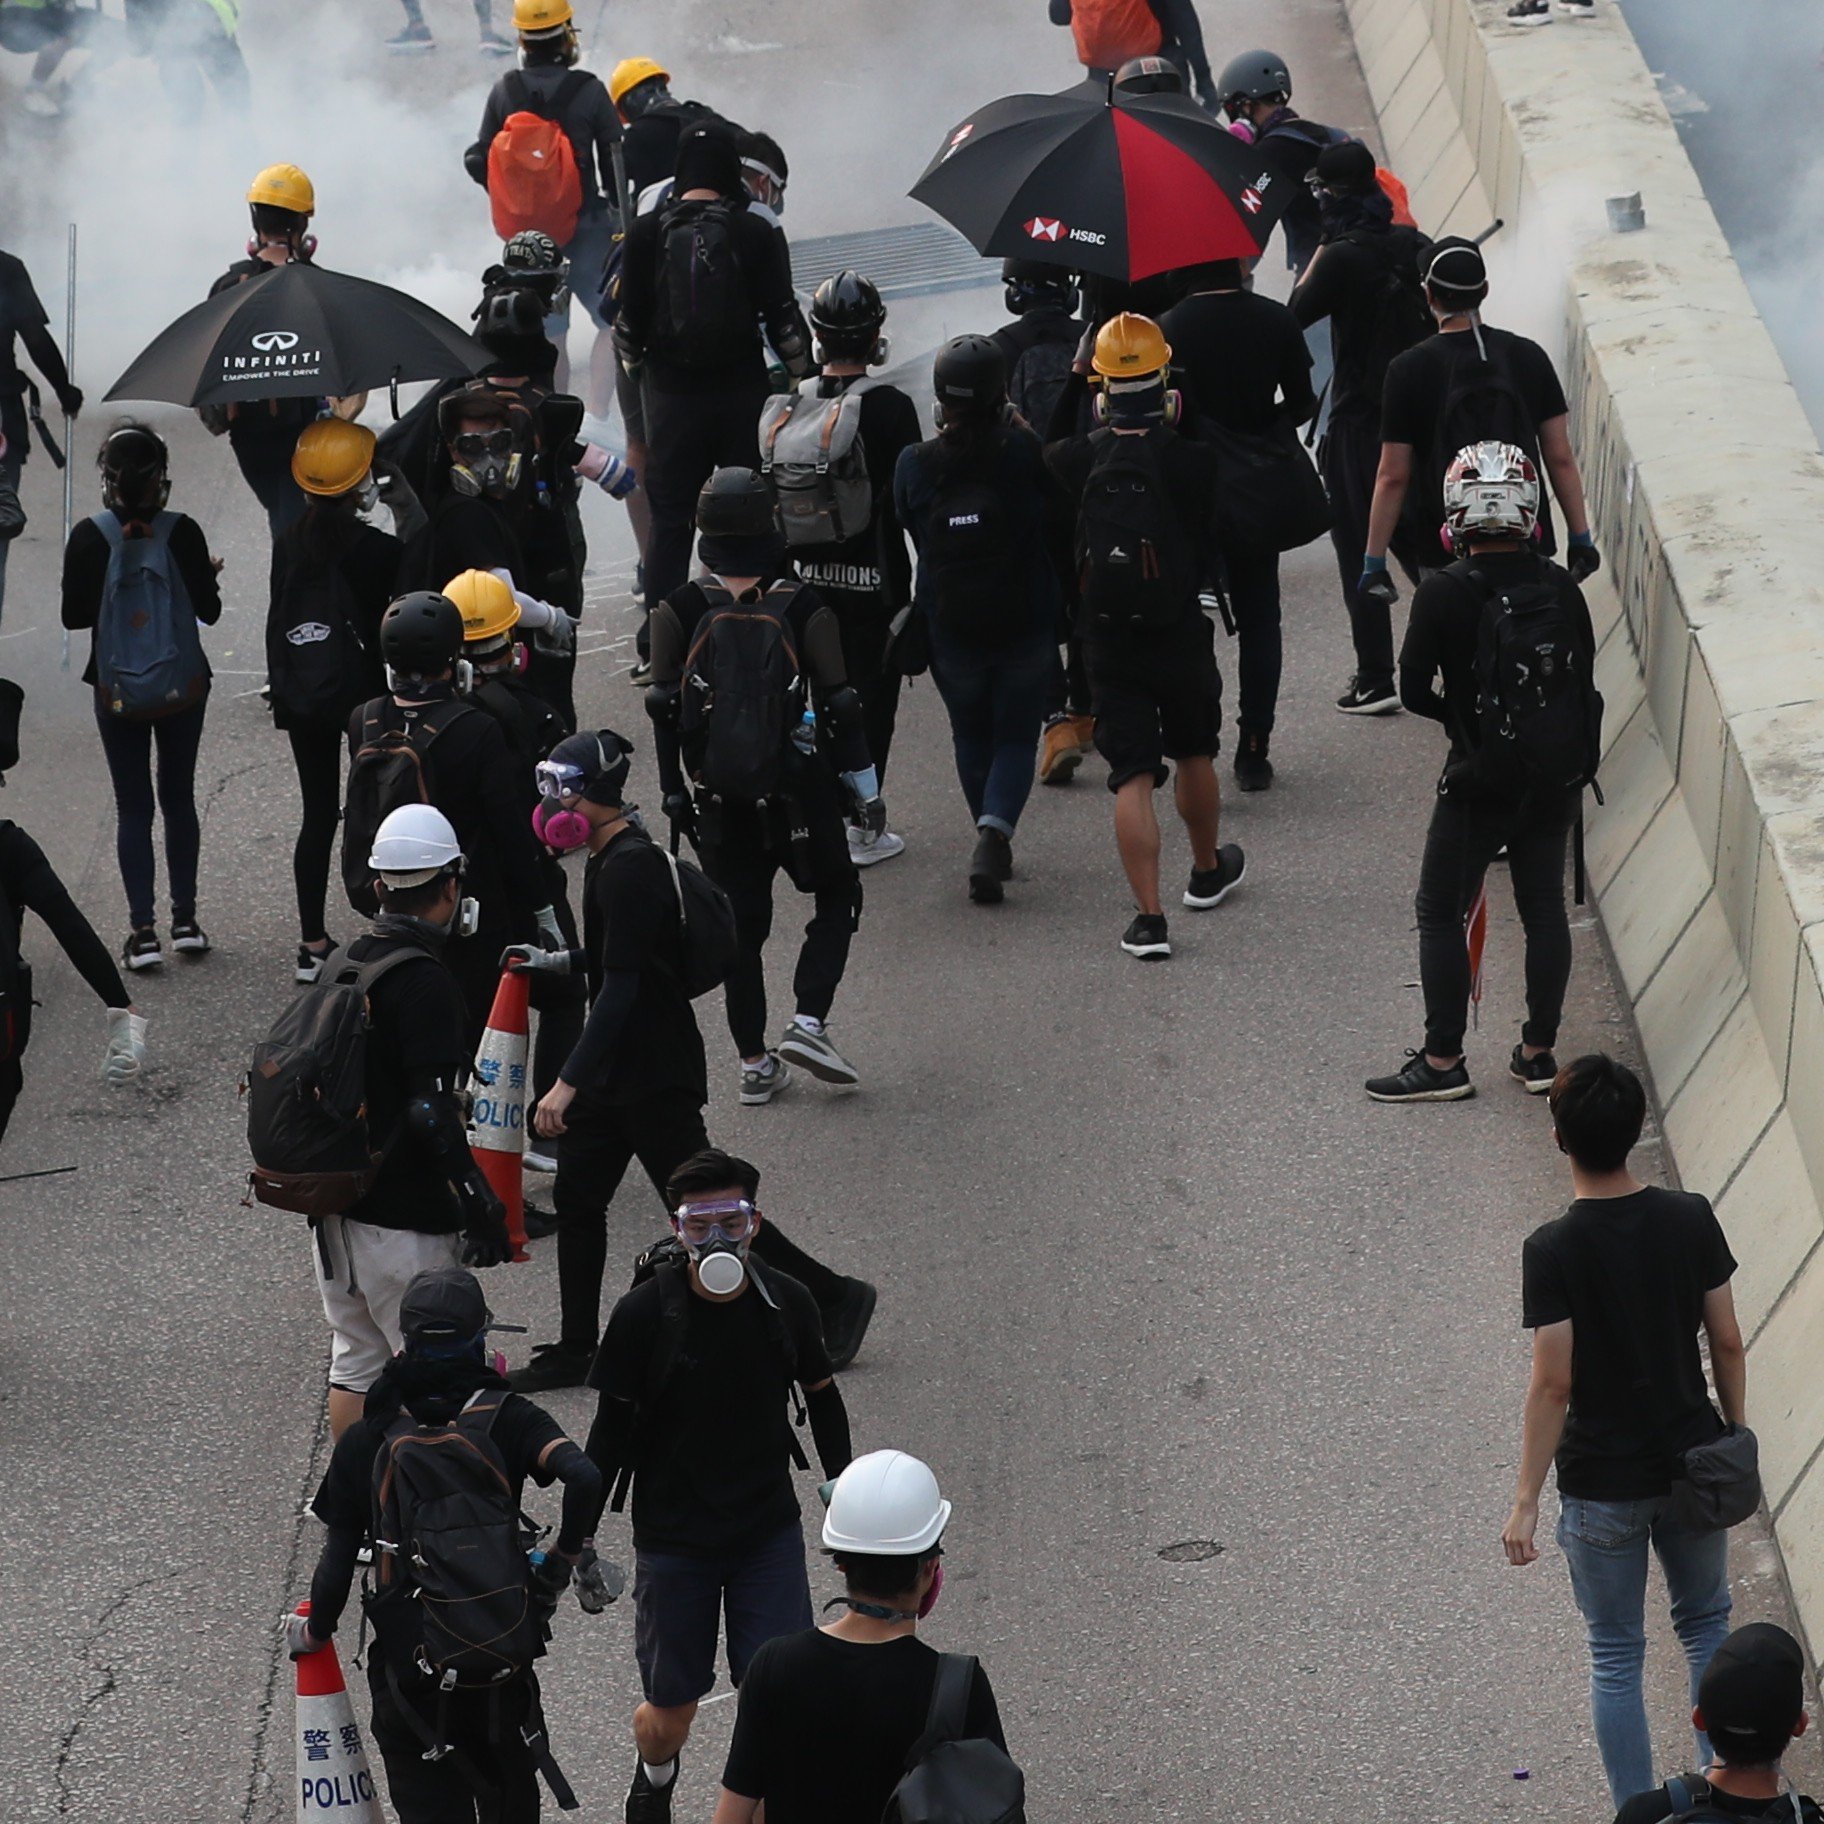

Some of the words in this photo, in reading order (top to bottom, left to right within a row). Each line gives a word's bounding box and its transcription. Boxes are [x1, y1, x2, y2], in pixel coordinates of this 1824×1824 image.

[1069, 228, 1107, 246] HSBC
[223, 350, 321, 369] INFINITI
[222, 370, 271, 382] EMPOWER
[272, 369, 291, 378] THE
[292, 367, 321, 377] DRIVE
[949, 513, 980, 527] PRESS
[478, 1058, 525, 1089] 警察
[474, 1098, 525, 1130] OLIC
[302, 1722, 364, 1762] 警察
[301, 1767, 378, 1810] POLIC
